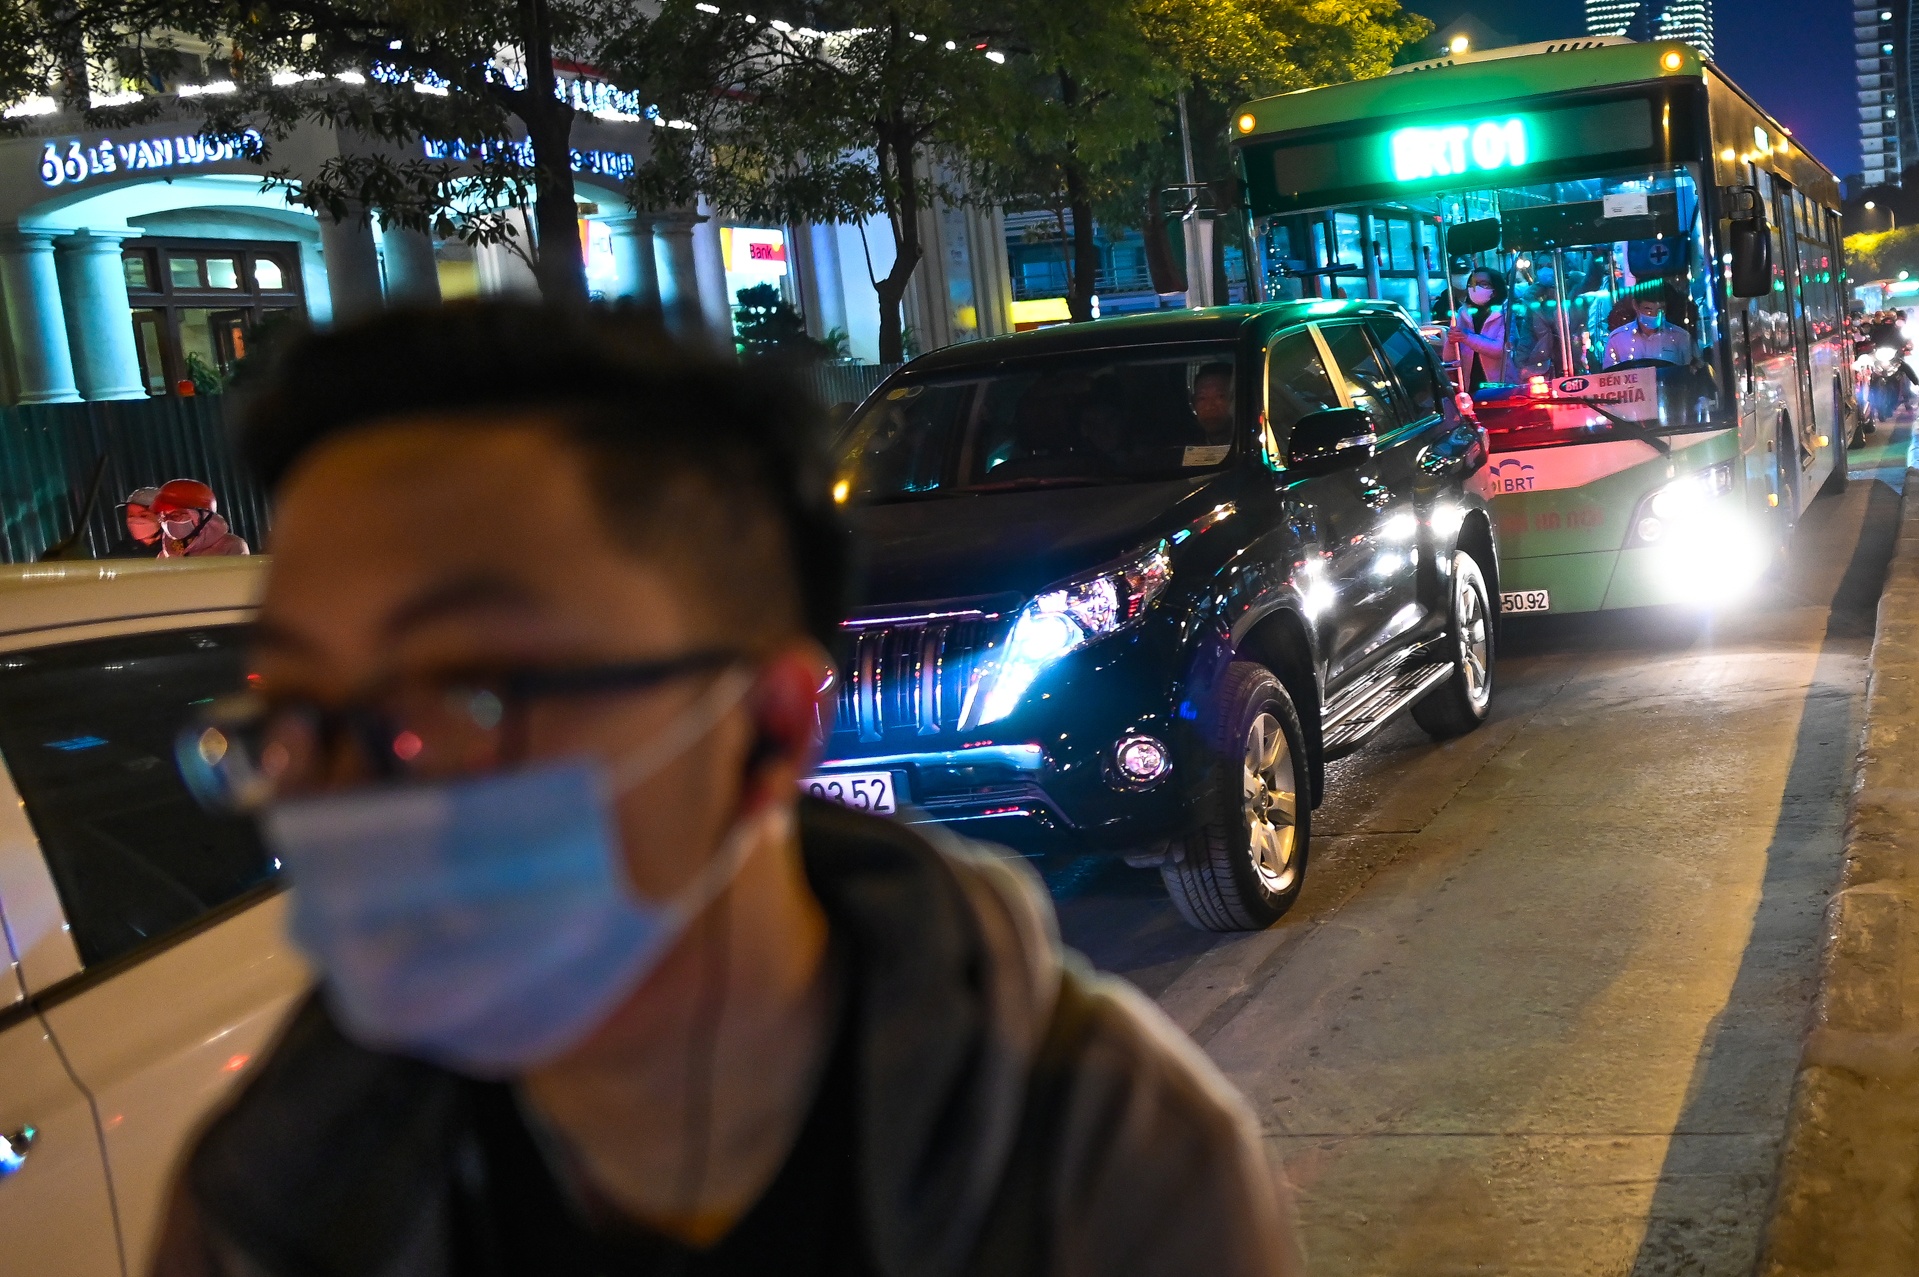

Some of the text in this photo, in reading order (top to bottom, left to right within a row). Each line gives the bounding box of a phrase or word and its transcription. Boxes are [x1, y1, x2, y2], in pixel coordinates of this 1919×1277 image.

[1472, 118, 1526, 170] 01
[39, 139, 89, 187] 66
[750, 243, 773, 259] Bank
[1565, 379, 1583, 392] BRT
[1623, 373, 1638, 384] XE
[1504, 476, 1535, 492] BRT
